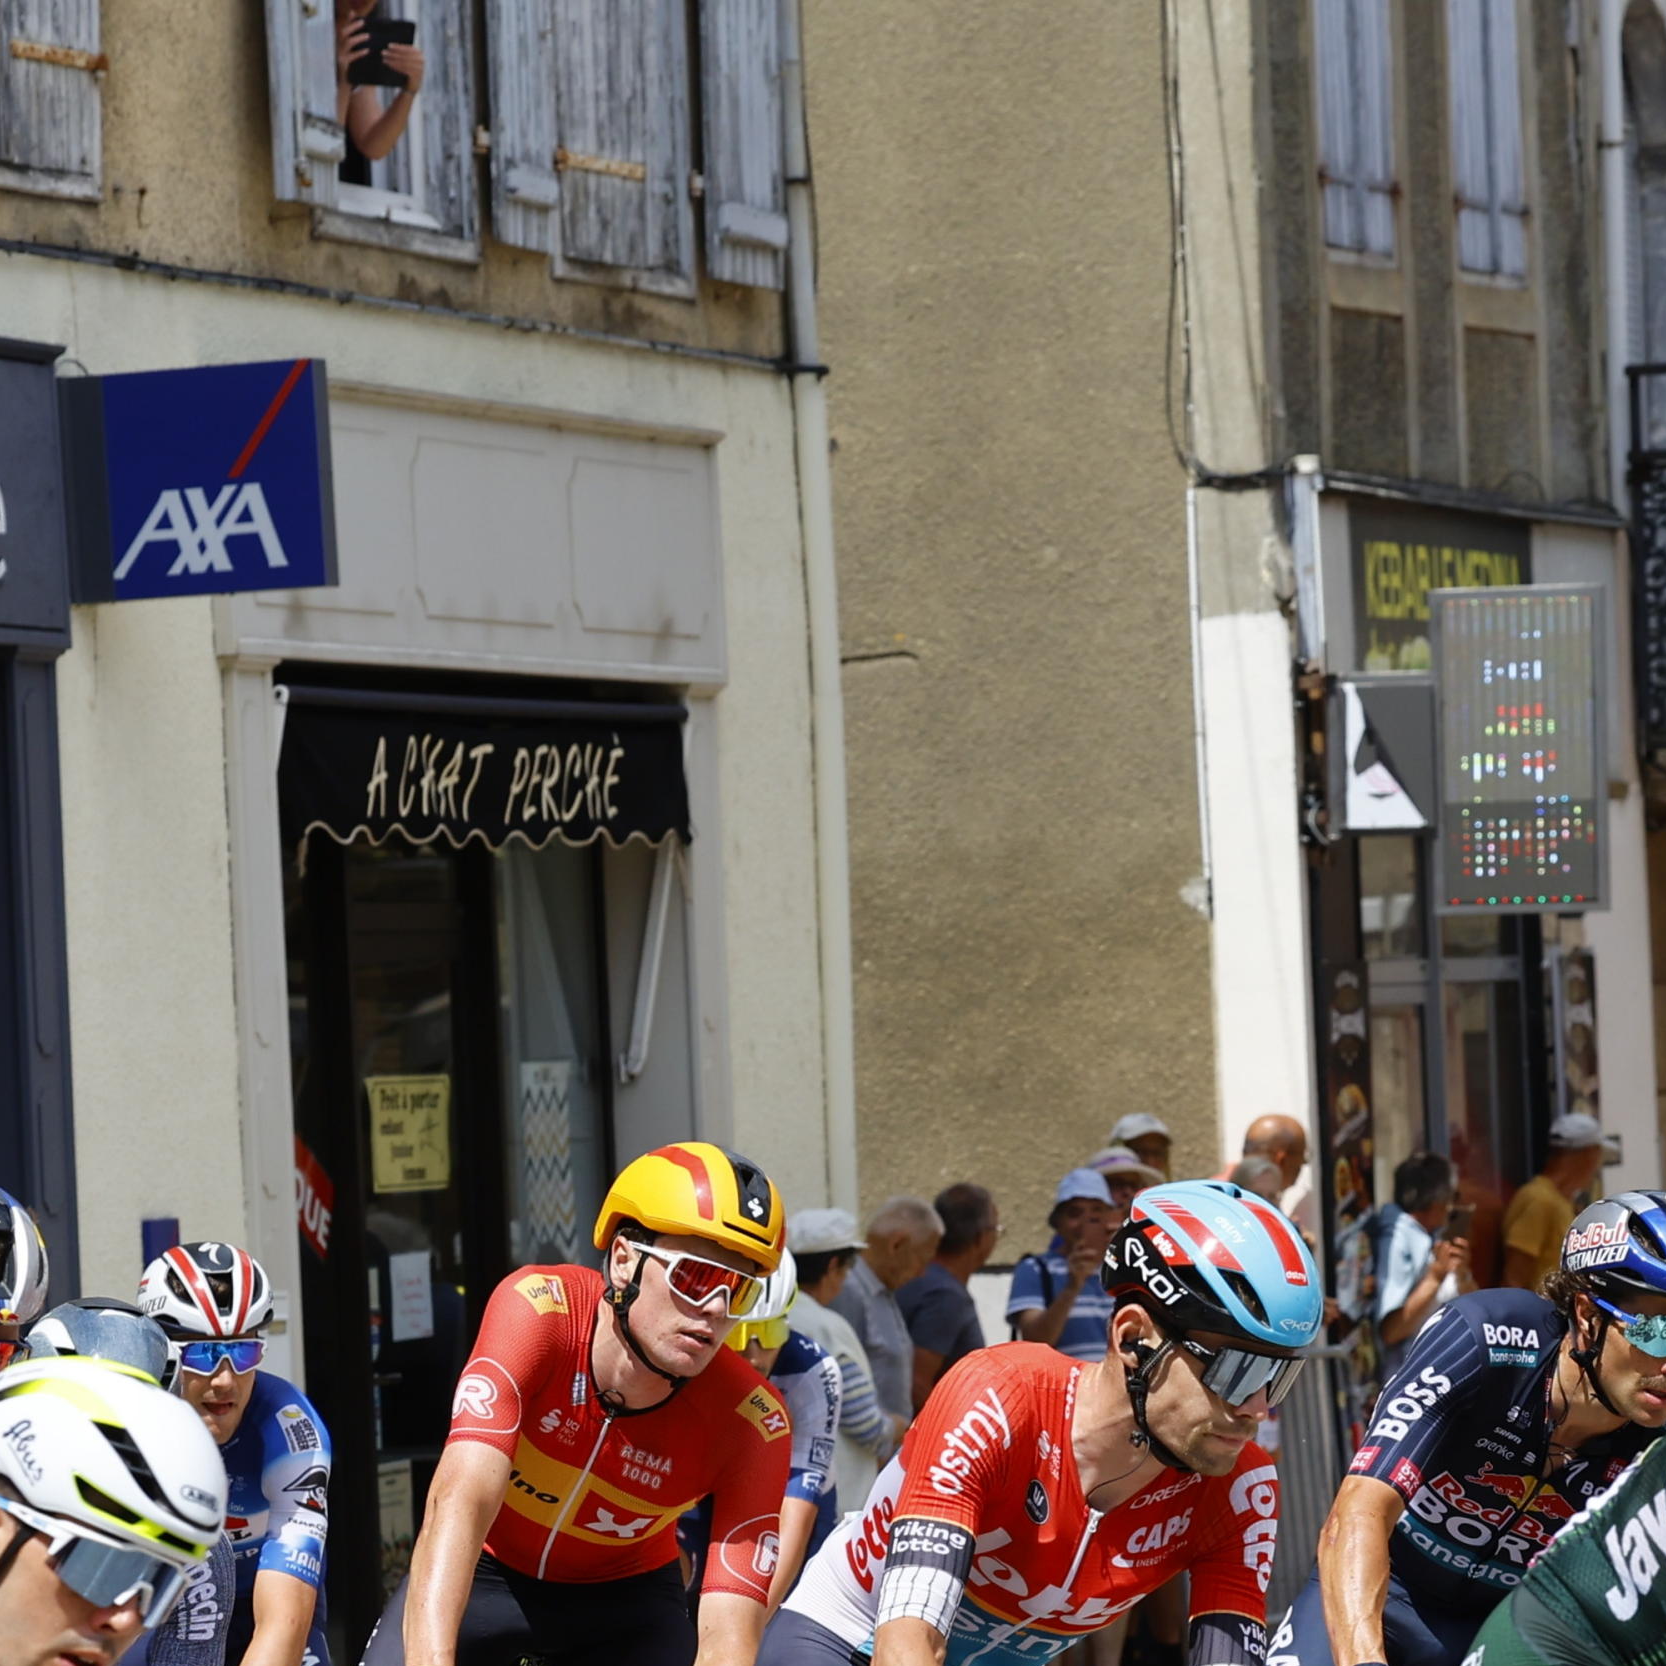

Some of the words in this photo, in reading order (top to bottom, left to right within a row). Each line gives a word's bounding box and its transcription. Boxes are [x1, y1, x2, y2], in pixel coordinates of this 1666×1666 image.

[114, 480, 289, 578] AXA
[397, 731, 495, 824] CHAT
[1566, 1244, 1630, 1272] SPECIALIZED
[527, 1285, 549, 1300] Uno
[1482, 1323, 1540, 1349] BORA
[1489, 1348, 1536, 1366] hansgrohe
[749, 1393, 770, 1414] Uno
[1371, 1366, 1452, 1442] BOSS
[564, 1417, 580, 1431] UCI
[929, 1387, 1012, 1496] dstny
[1474, 1436, 1516, 1461] grenke
[620, 1444, 673, 1476] REMA
[621, 1462, 662, 1490] 1000
[1428, 1470, 1516, 1531] Red
[893, 1520, 968, 1551] viking
[1125, 1506, 1194, 1555] CAPS
[1407, 1485, 1531, 1566] BOR
[892, 1537, 951, 1555] lotto
[1395, 1512, 1523, 1588] hansgro
[1238, 1622, 1267, 1644] viki
